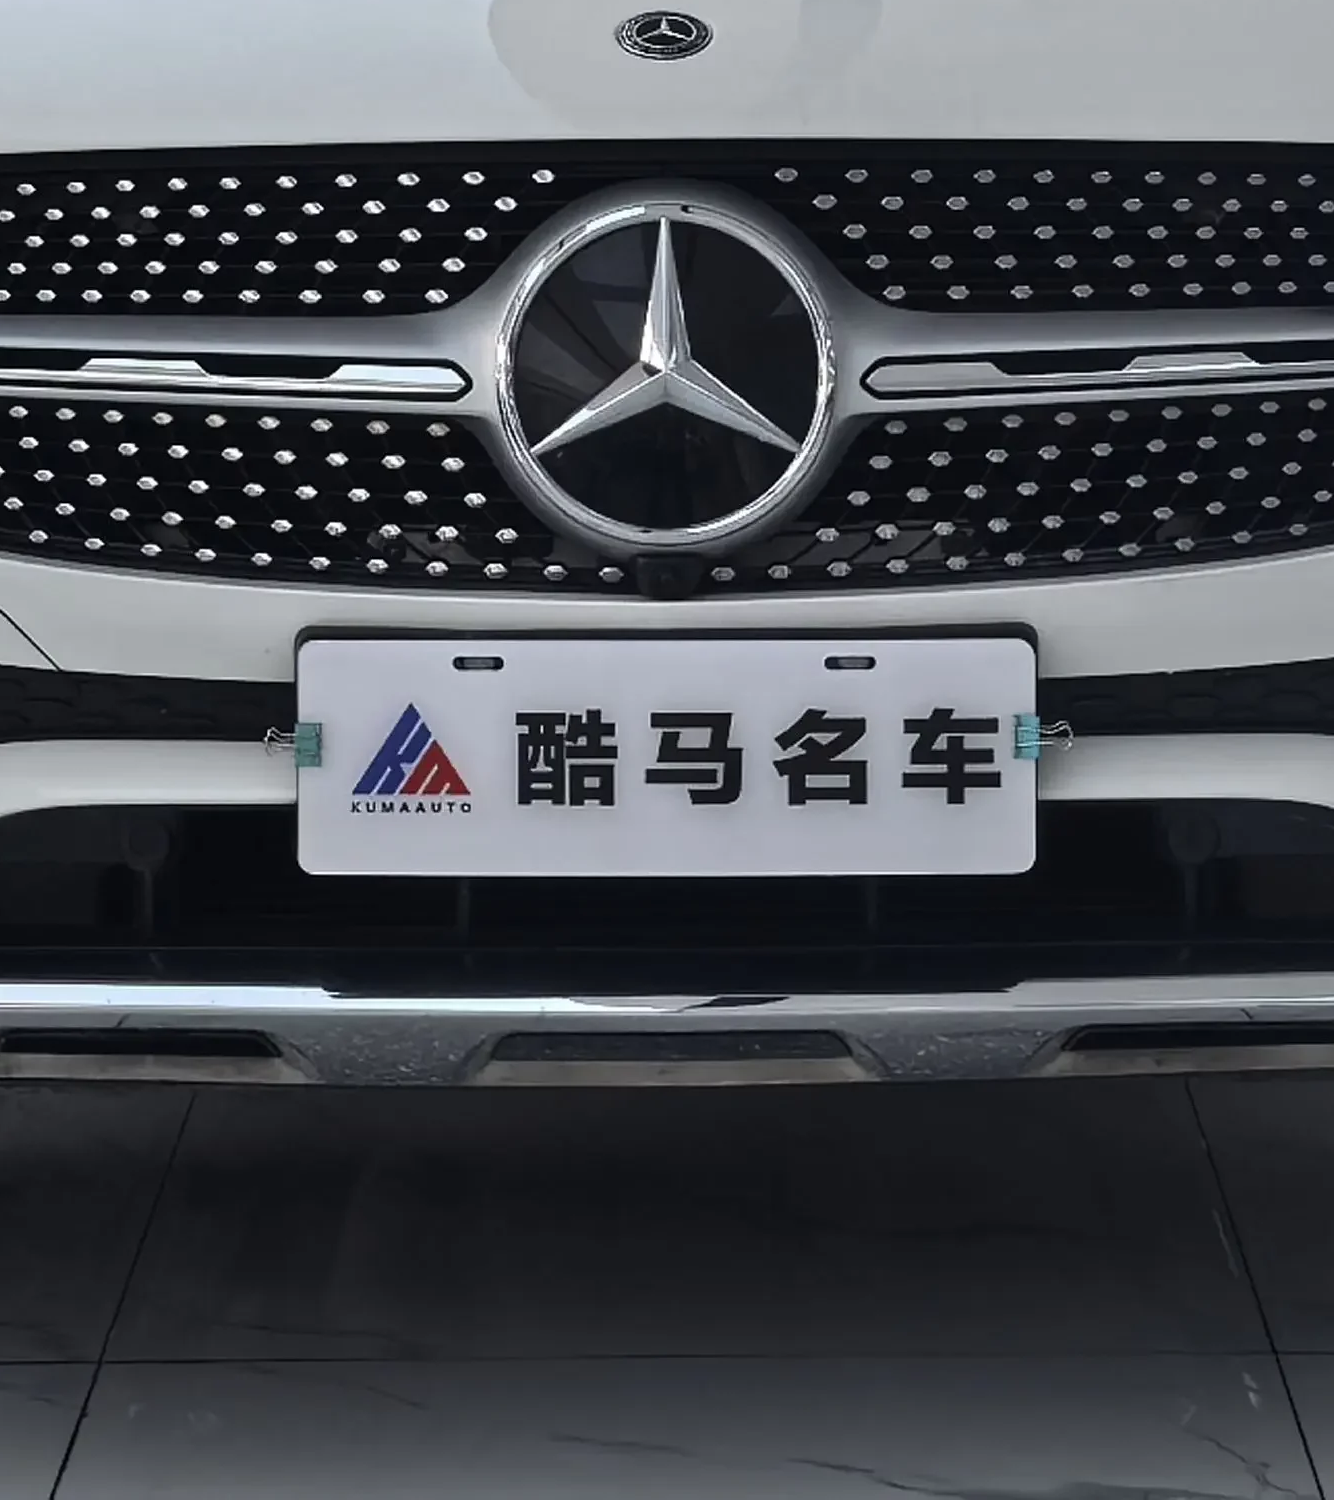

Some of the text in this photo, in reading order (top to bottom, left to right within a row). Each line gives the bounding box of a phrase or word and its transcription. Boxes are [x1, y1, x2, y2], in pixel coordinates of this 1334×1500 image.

[514, 707, 1002, 807] 酷马名车
[351, 801, 472, 814] KUMAAUTO
